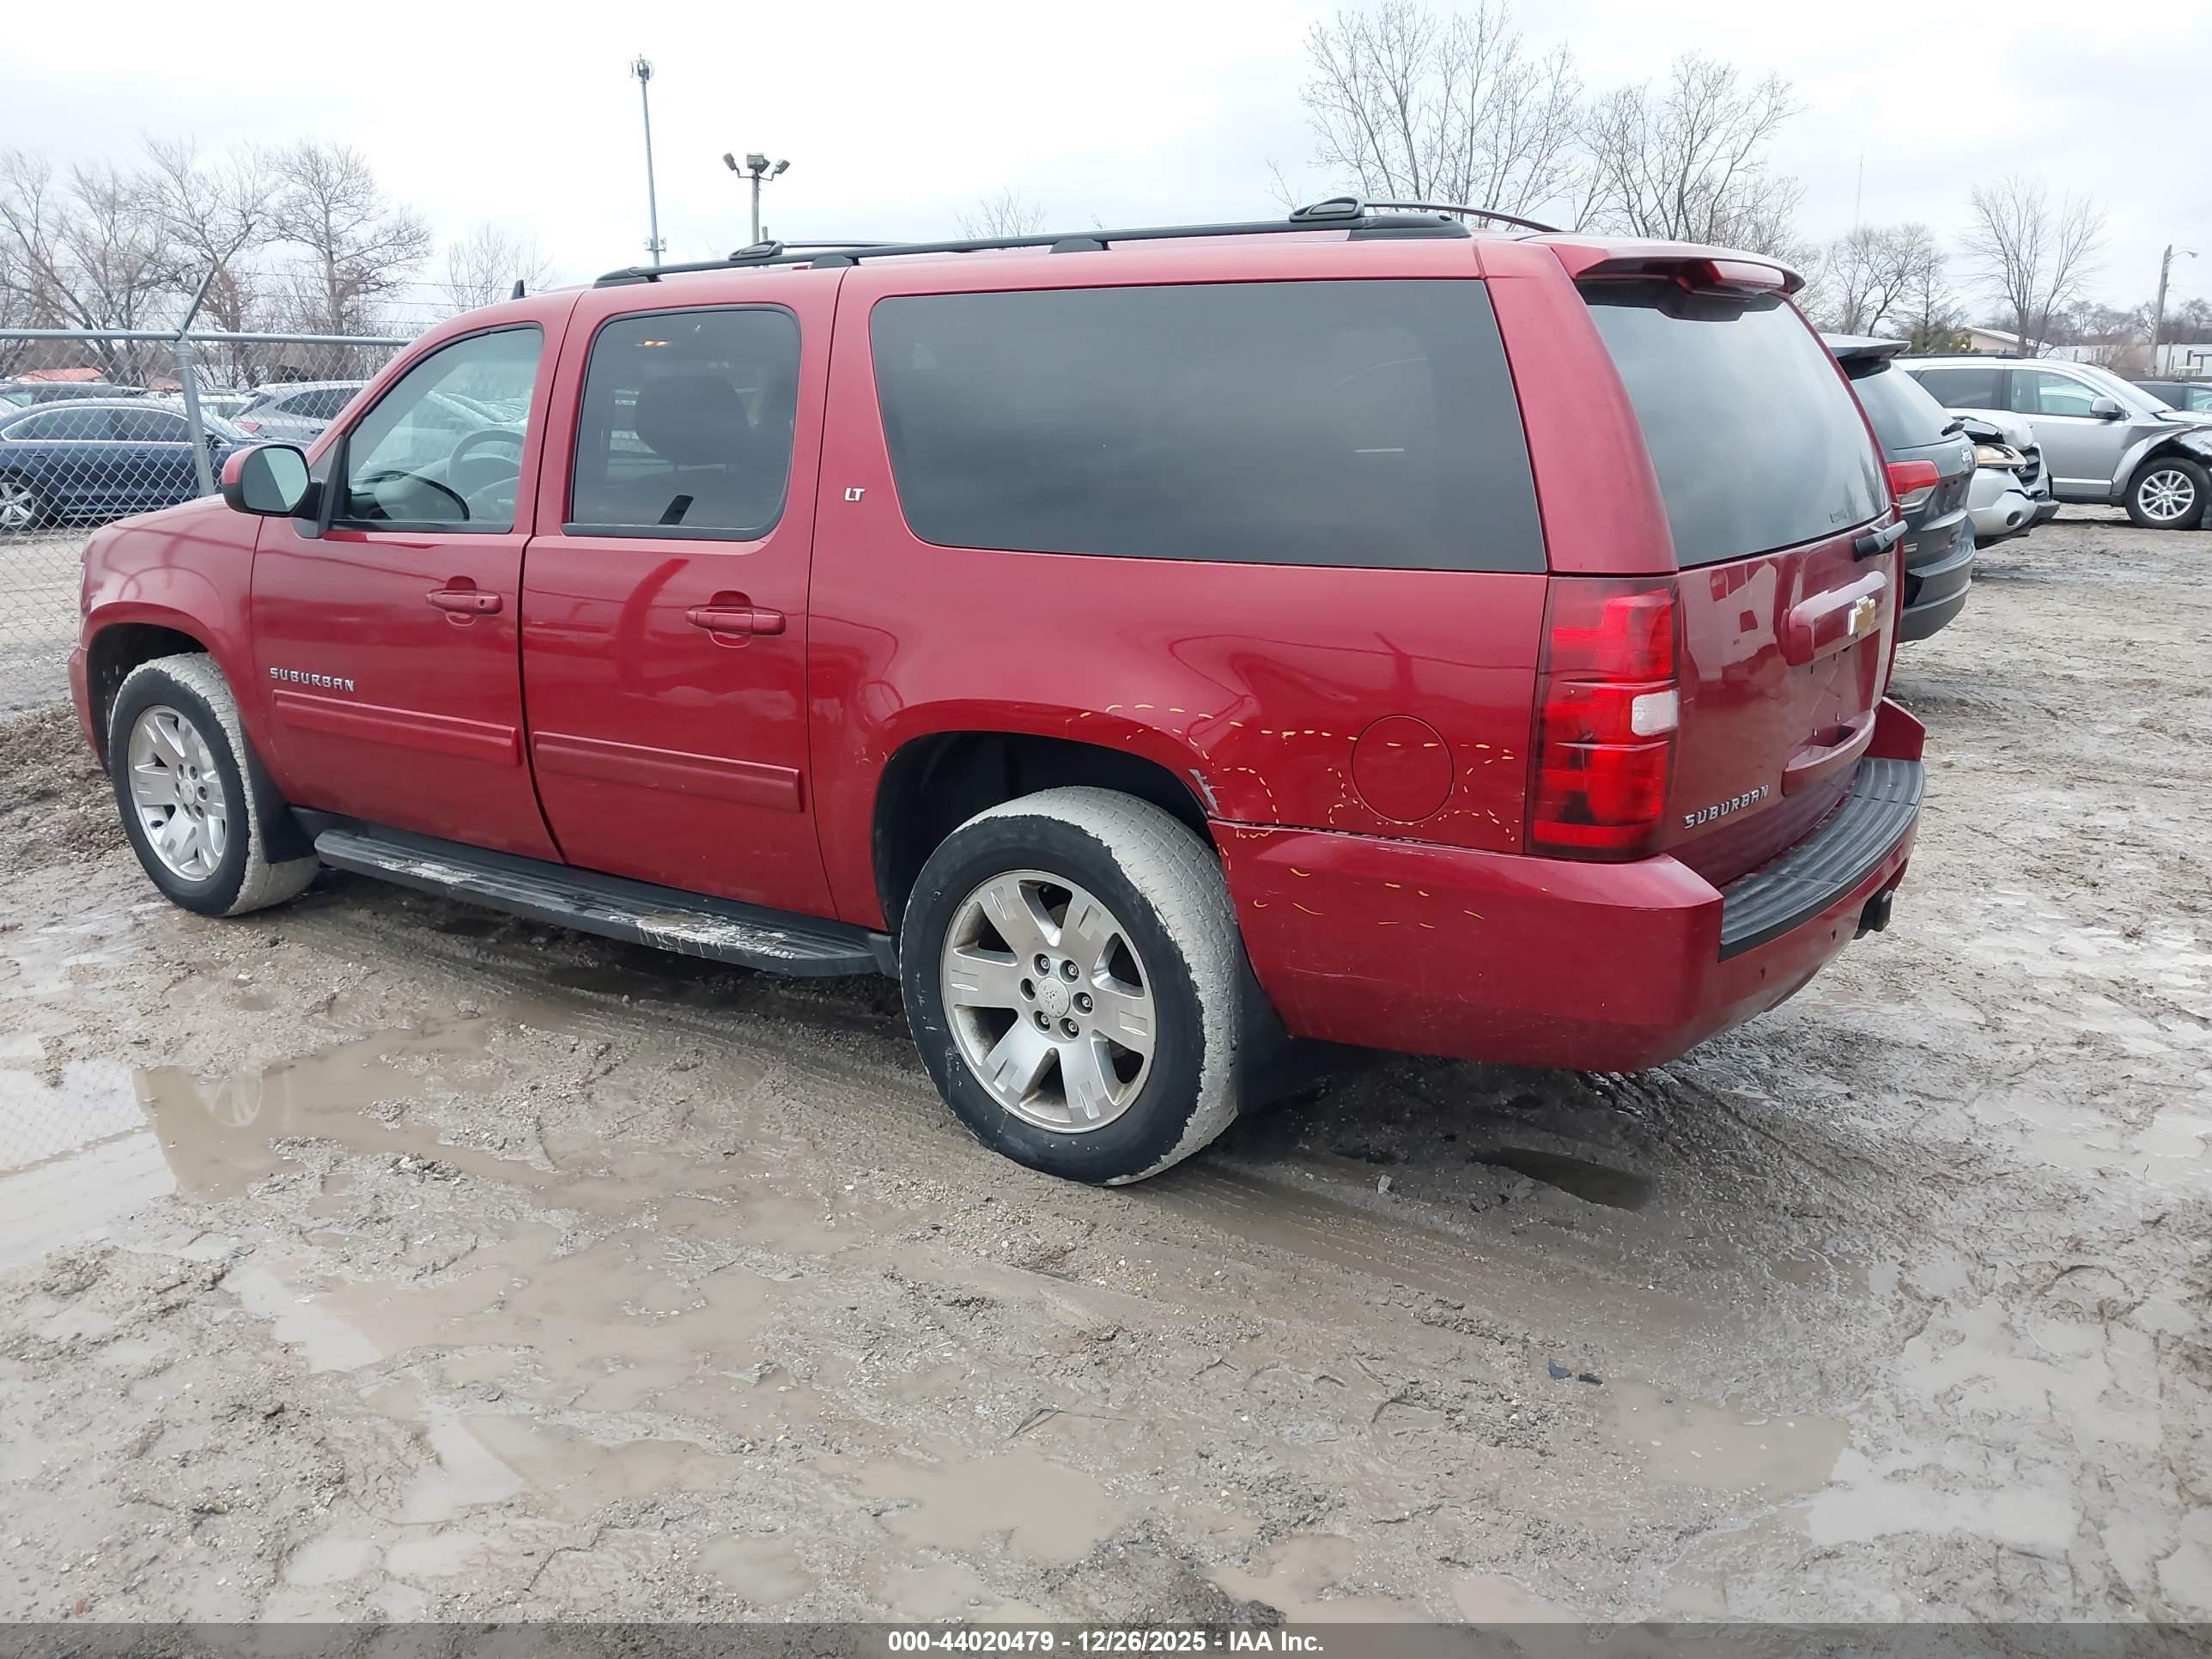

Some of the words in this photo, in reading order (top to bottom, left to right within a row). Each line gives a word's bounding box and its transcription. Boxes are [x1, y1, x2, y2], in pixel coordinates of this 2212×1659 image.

[844, 487, 866, 502] LT
[270, 666, 355, 692] SUBURBAN
[1683, 784, 1770, 830] SUBURBAN
